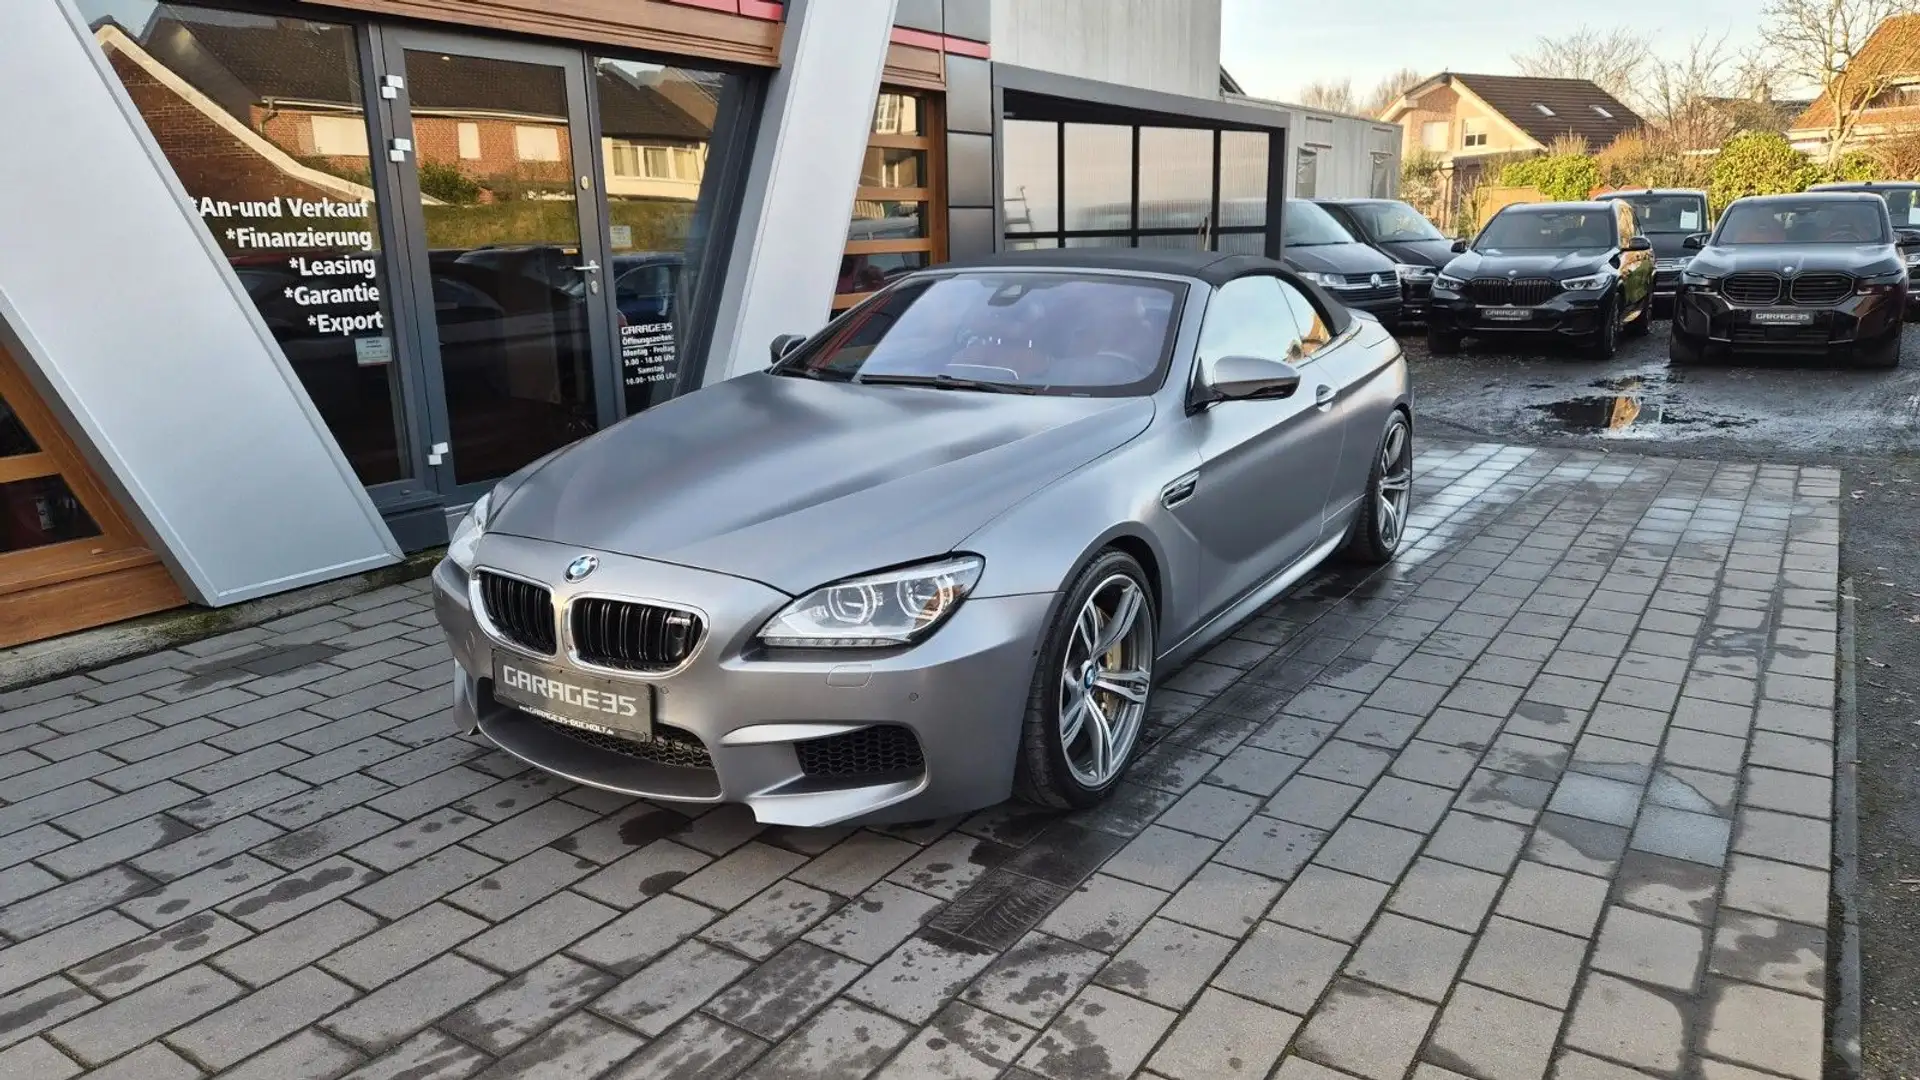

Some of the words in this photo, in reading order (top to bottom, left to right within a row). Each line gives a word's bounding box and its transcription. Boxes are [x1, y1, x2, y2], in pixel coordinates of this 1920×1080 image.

[287, 196, 369, 218] Verkauf
[621, 322, 673, 335] GARAGE35
[622, 348, 648, 357] Montag
[653, 345, 675, 354] Freitag
[637, 366, 664, 374] Samstag
[665, 372, 677, 380] Uhr
[503, 664, 638, 718] GARAGE35
